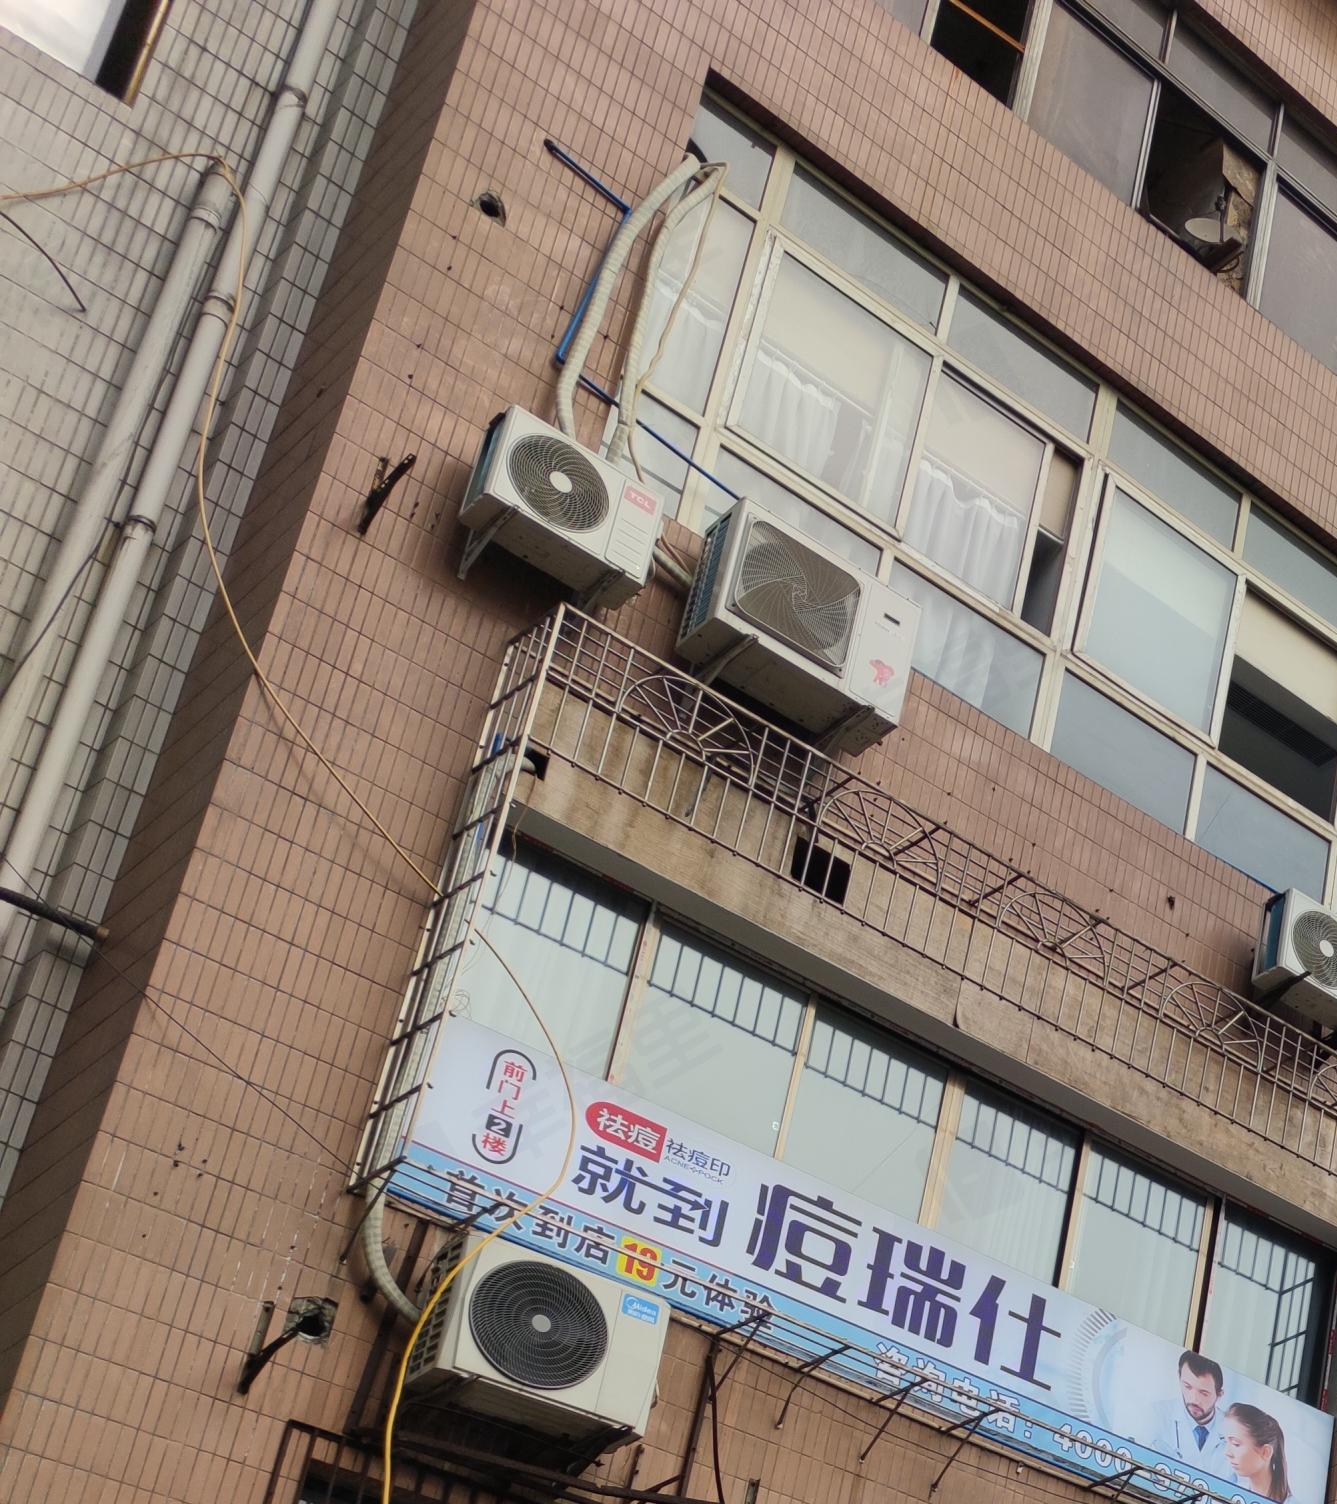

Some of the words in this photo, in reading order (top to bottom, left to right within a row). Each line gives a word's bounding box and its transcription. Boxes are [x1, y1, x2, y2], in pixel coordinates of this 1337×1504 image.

[629, 490, 653, 510] TCL
[481, 1060, 527, 1156] 前门上2楼
[596, 1106, 663, 1155] 祛痘
[665, 1137, 732, 1178] 祛痘印
[571, 1144, 730, 1248] 就到
[746, 1183, 1062, 1392] 痘瑞仕
